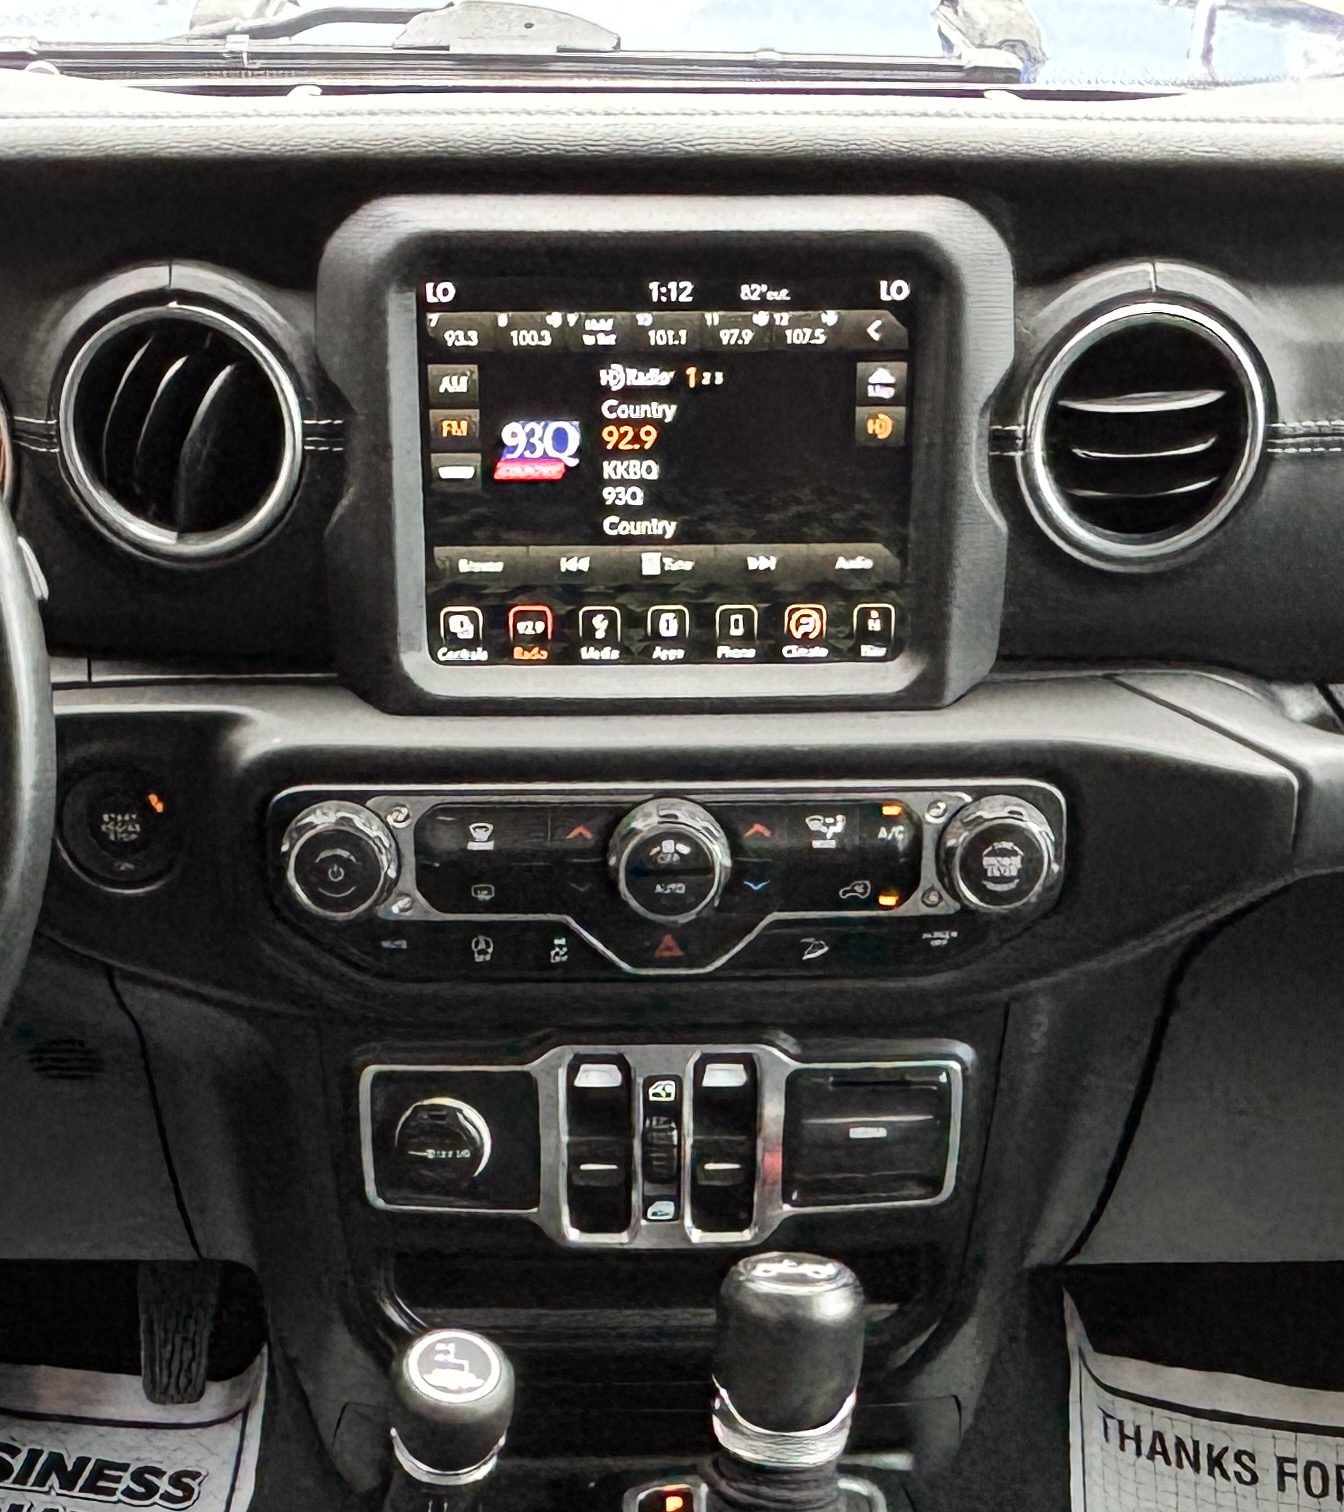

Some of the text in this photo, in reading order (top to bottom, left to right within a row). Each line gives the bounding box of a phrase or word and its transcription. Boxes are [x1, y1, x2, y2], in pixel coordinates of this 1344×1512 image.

[425, 282, 455, 303] LO
[649, 281, 693, 303] 1:12
[880, 279, 910, 301] LO
[443, 329, 479, 347] 93.3
[510, 329, 552, 347] 100.3
[648, 329, 688, 346] 101.1
[719, 328, 754, 346] 97.9
[785, 328, 827, 345] 107.5
[439, 376, 468, 392] AM
[686, 366, 697, 388] 1
[601, 399, 678, 423] Country
[501, 420, 581, 467] 93Q
[601, 425, 658, 450] 92.9
[602, 516, 677, 539] Country
[878, 825, 904, 840] A/C
[1097, 1405, 1260, 1486] THANKS
[666, 1496, 683, 1512] P
